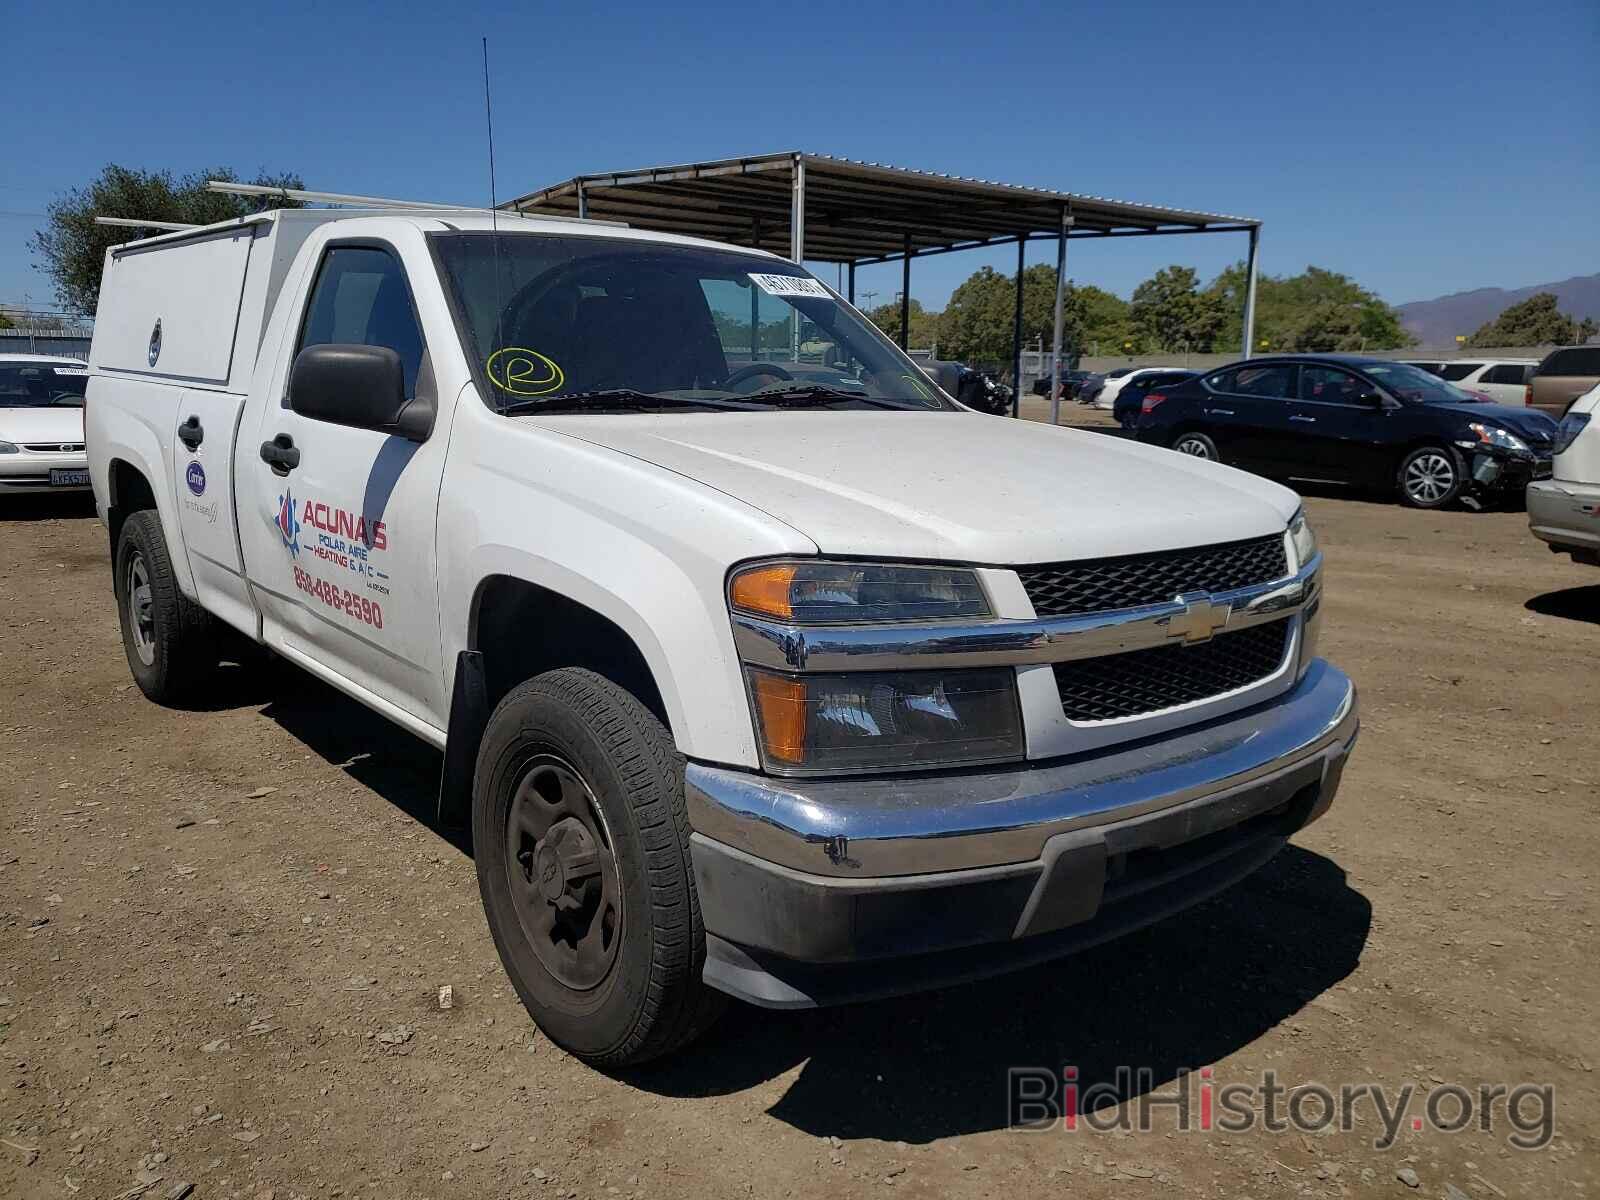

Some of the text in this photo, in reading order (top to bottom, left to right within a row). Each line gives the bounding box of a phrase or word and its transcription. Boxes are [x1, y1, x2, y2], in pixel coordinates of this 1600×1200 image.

[313, 545, 348, 568] HEATING
[350, 560, 357, 571] &
[318, 533, 368, 561] POLAR AIRE
[293, 565, 383, 629] 858-486-2590
